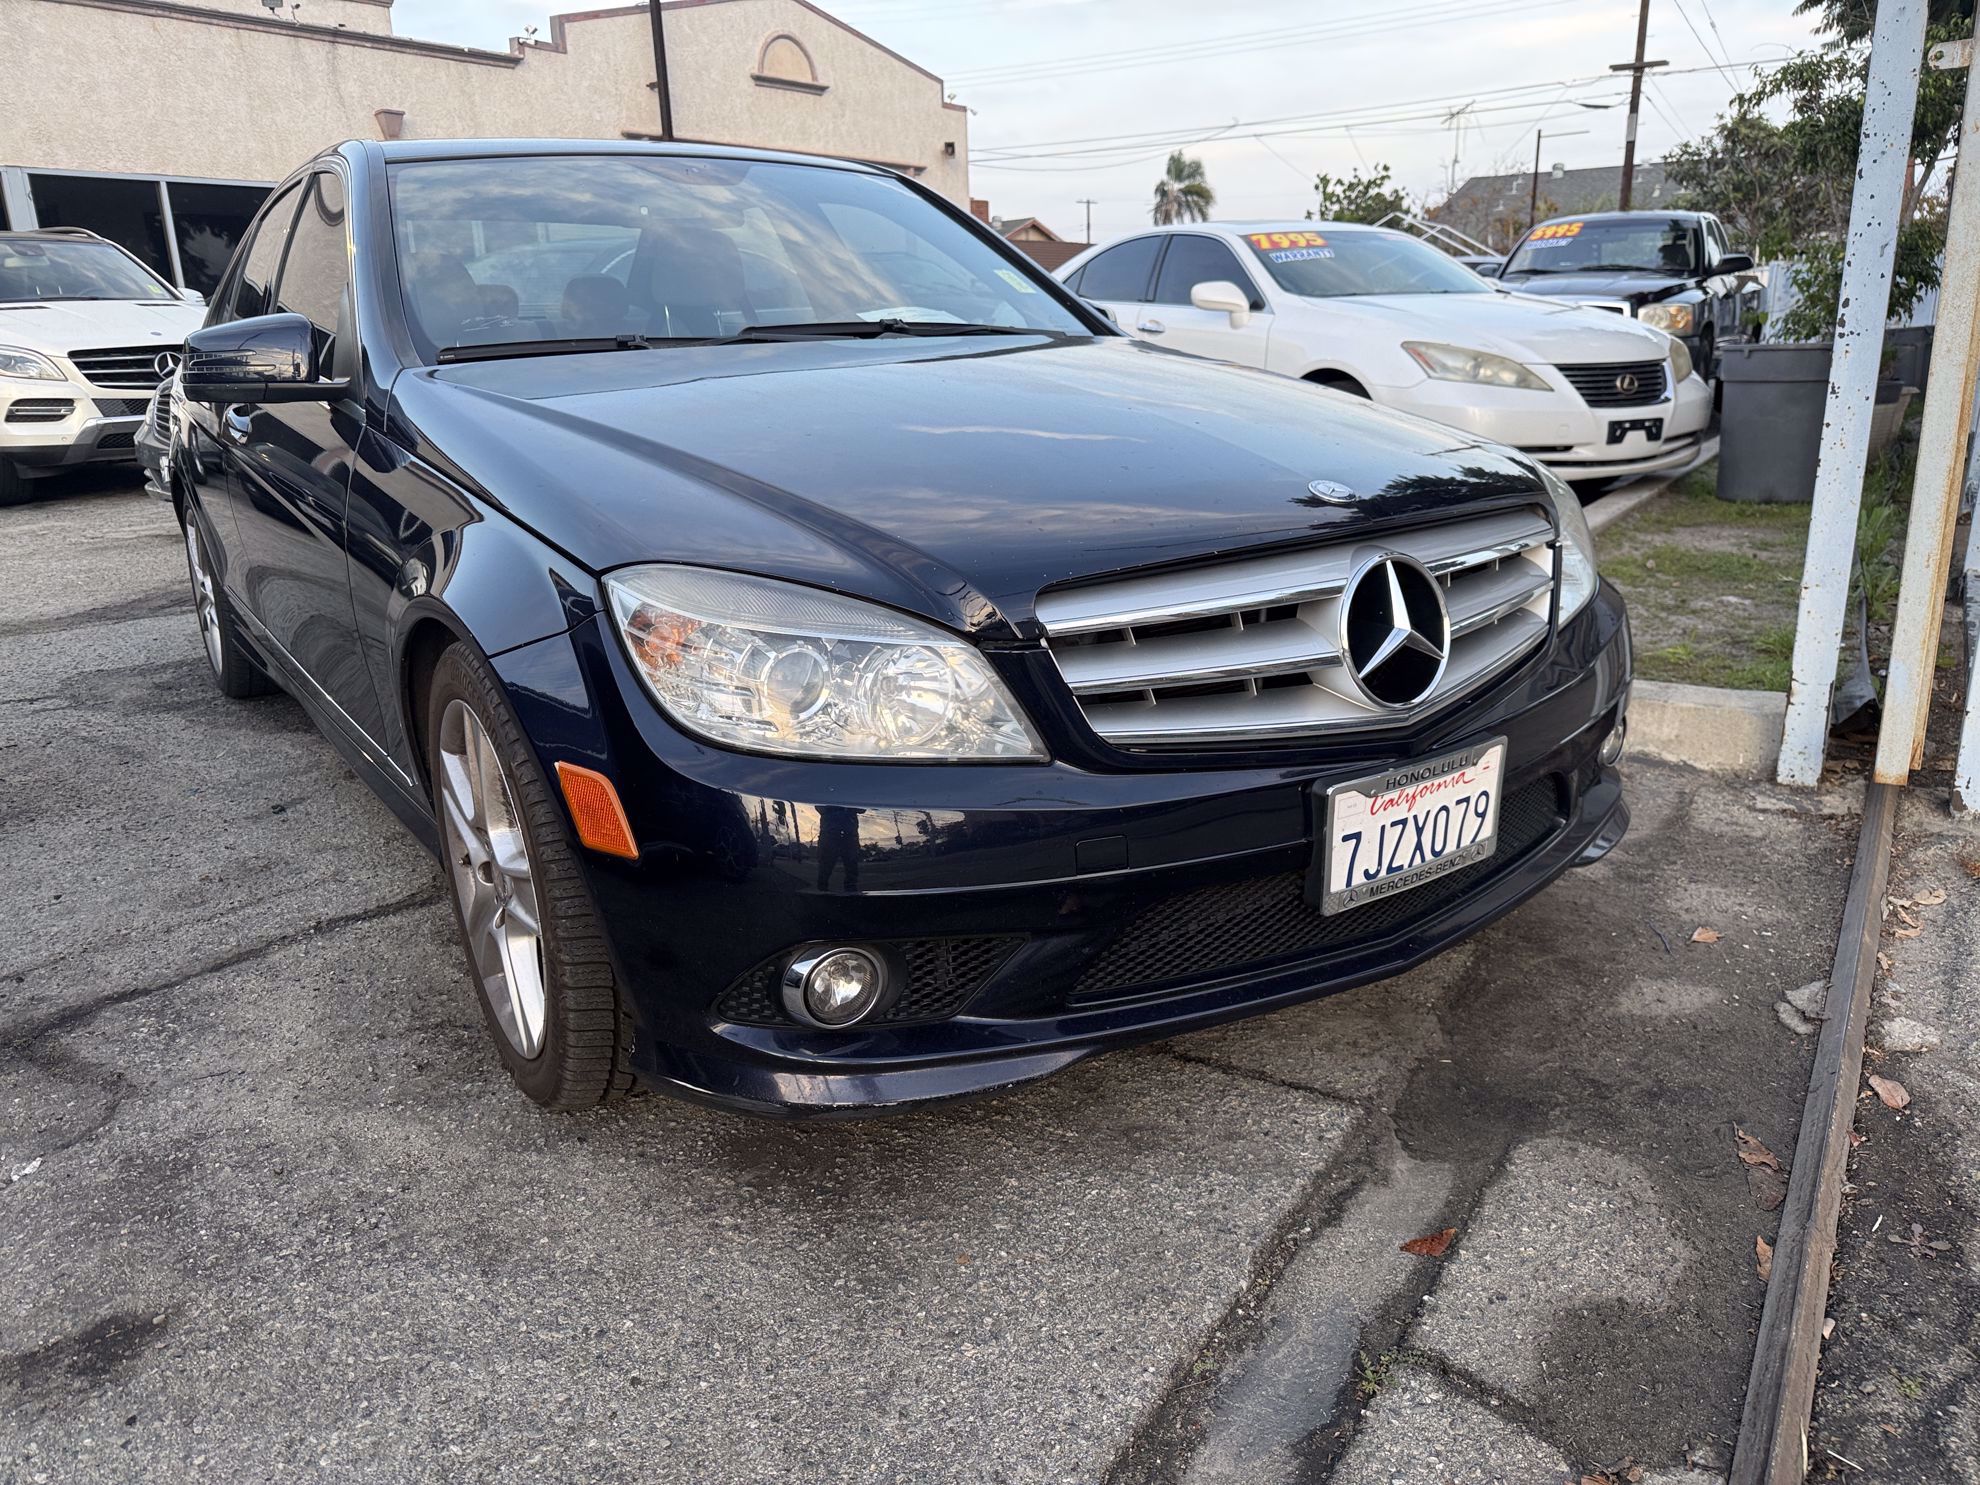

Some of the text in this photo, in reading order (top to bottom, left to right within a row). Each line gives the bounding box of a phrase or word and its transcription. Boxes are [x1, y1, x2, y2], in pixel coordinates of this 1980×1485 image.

[1250, 232, 1327, 249] 7995
[1529, 222, 1584, 240] 5995
[1271, 250, 1333, 263] WARRANTY
[1385, 755, 1469, 790] HONOLULU
[1370, 771, 1475, 816] California
[1341, 790, 1490, 888] 7JZX079
[1369, 855, 1462, 898] MERCEDES-BENZ
